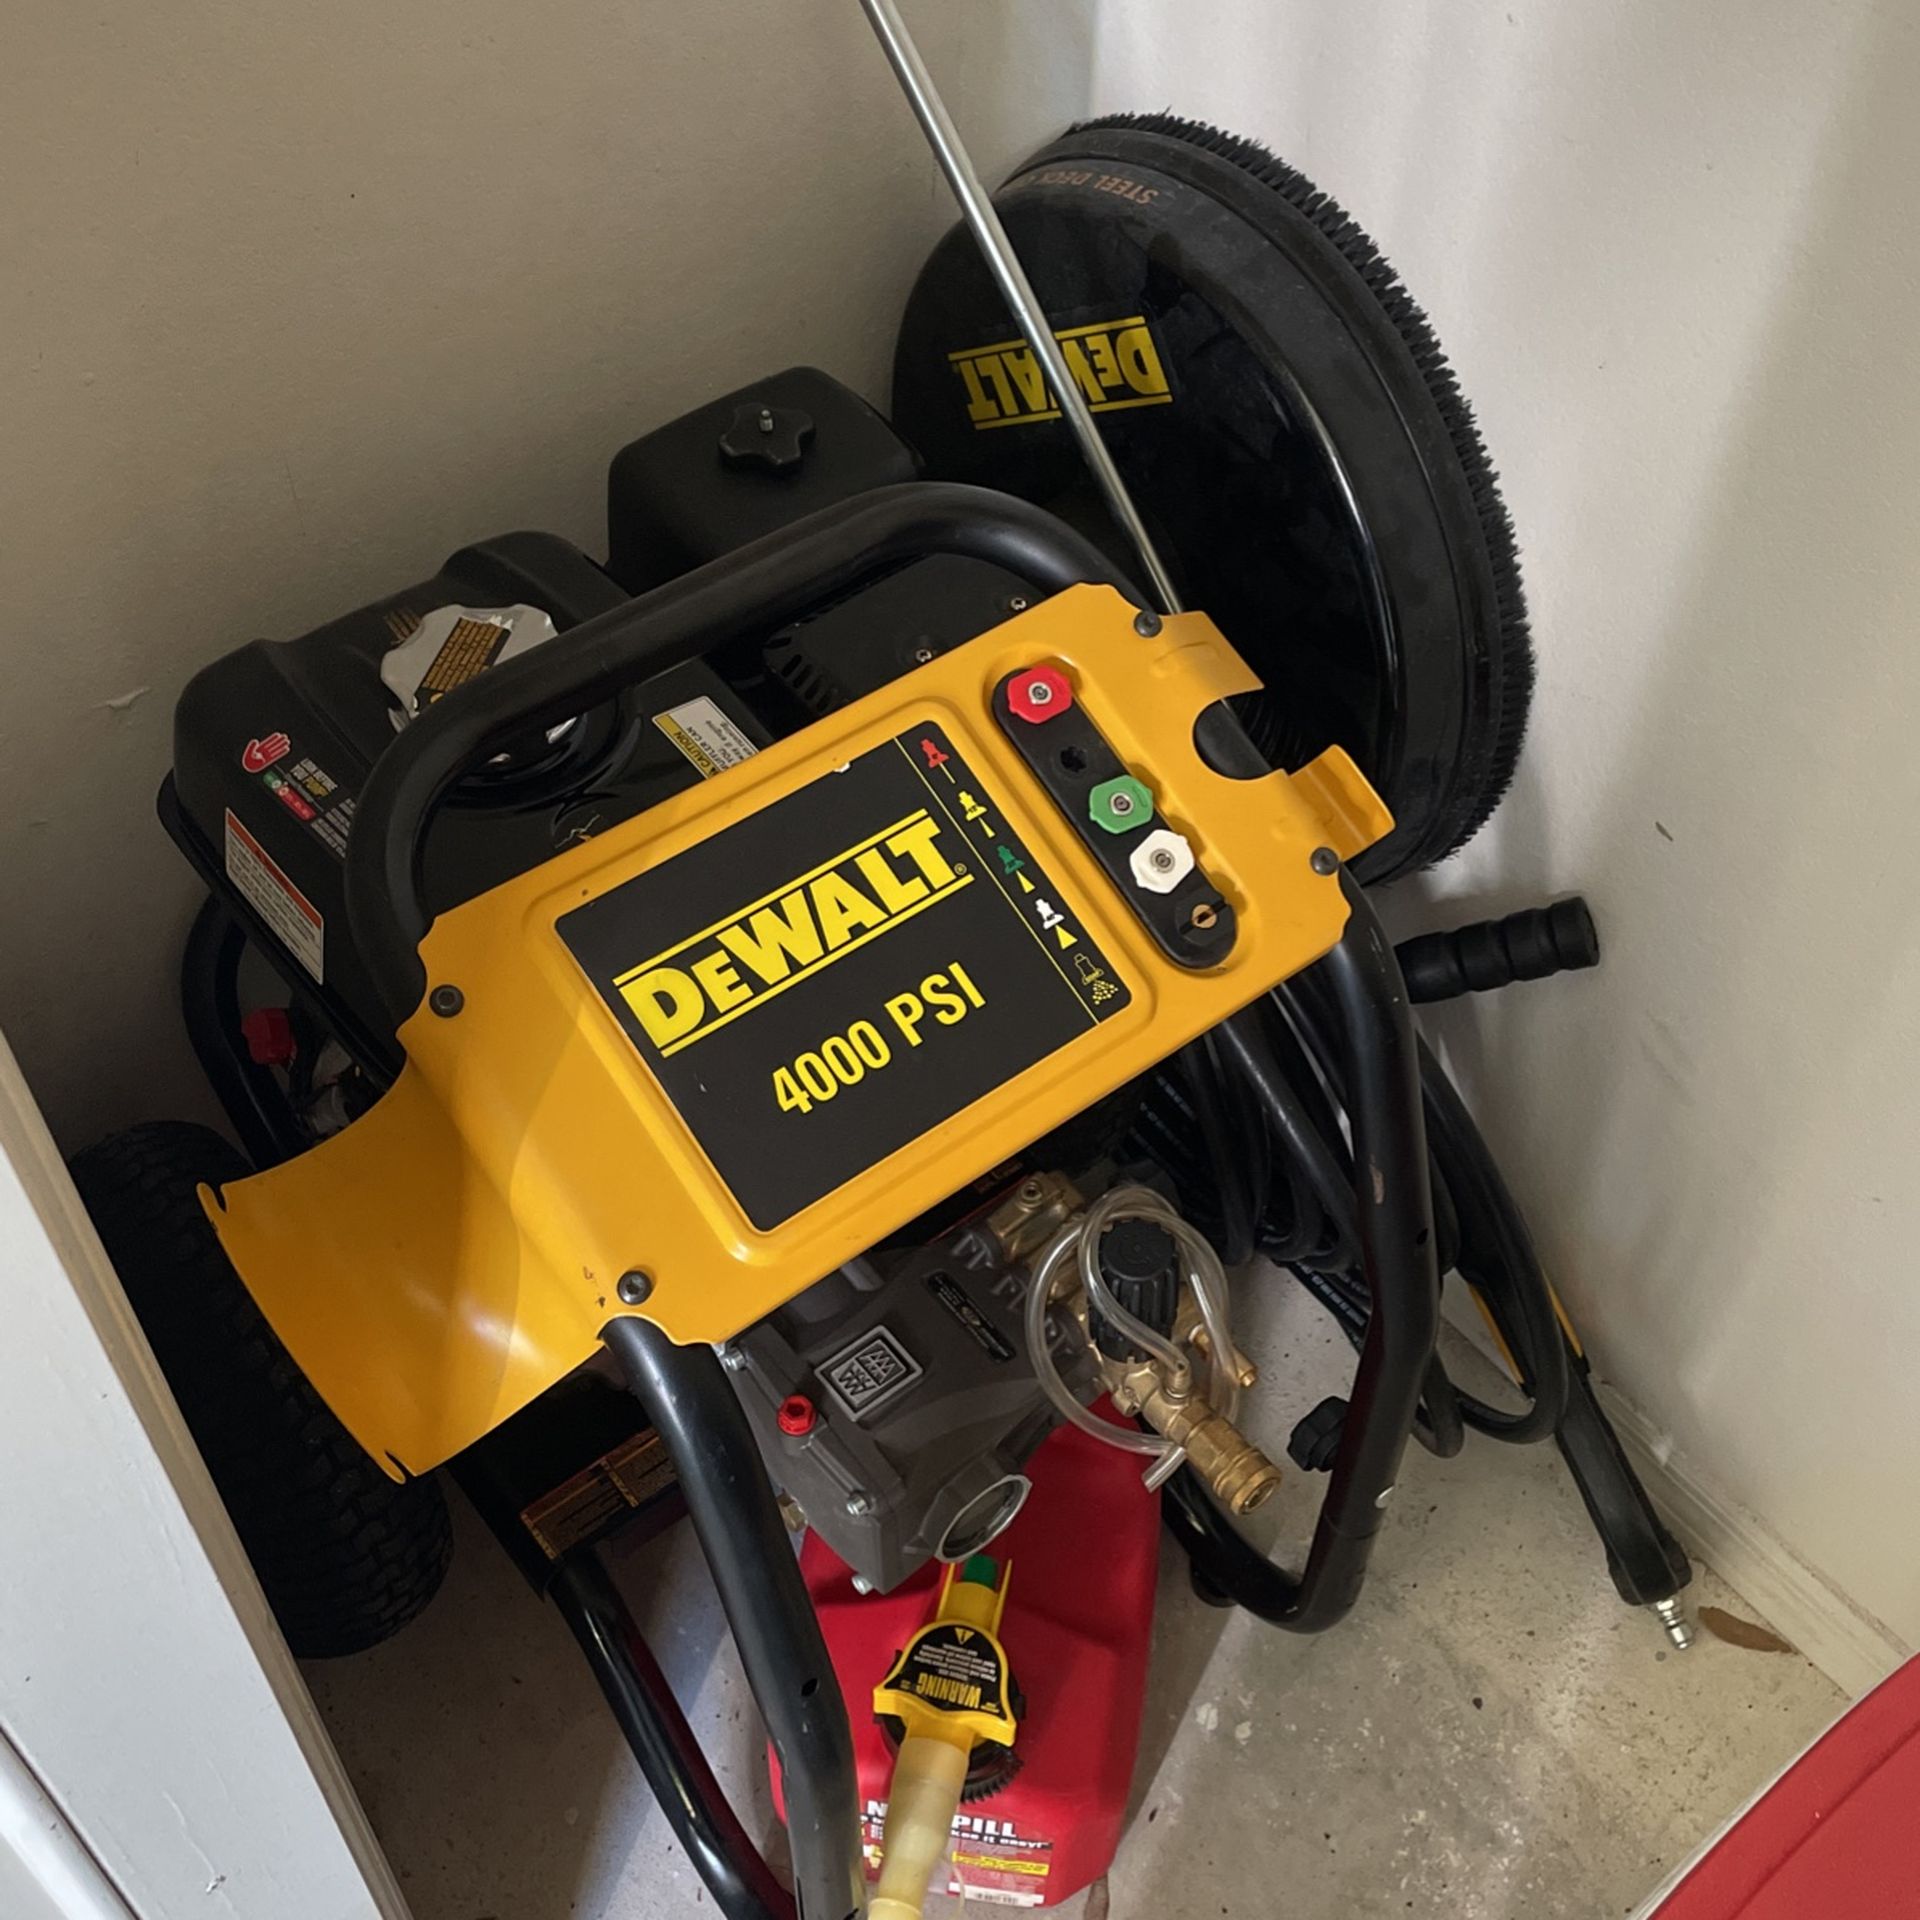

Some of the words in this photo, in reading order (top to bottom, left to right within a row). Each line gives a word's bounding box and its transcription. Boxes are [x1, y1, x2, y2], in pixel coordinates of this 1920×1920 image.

[1092, 175, 1159, 205] STEEL
[674, 730, 711, 767] CAUTION
[771, 1019, 893, 1115] 4000
[883, 961, 987, 1048] PSI
[915, 1672, 982, 1708] WARNING
[867, 1800, 889, 1818] N
[951, 1814, 1017, 1838] PILL
